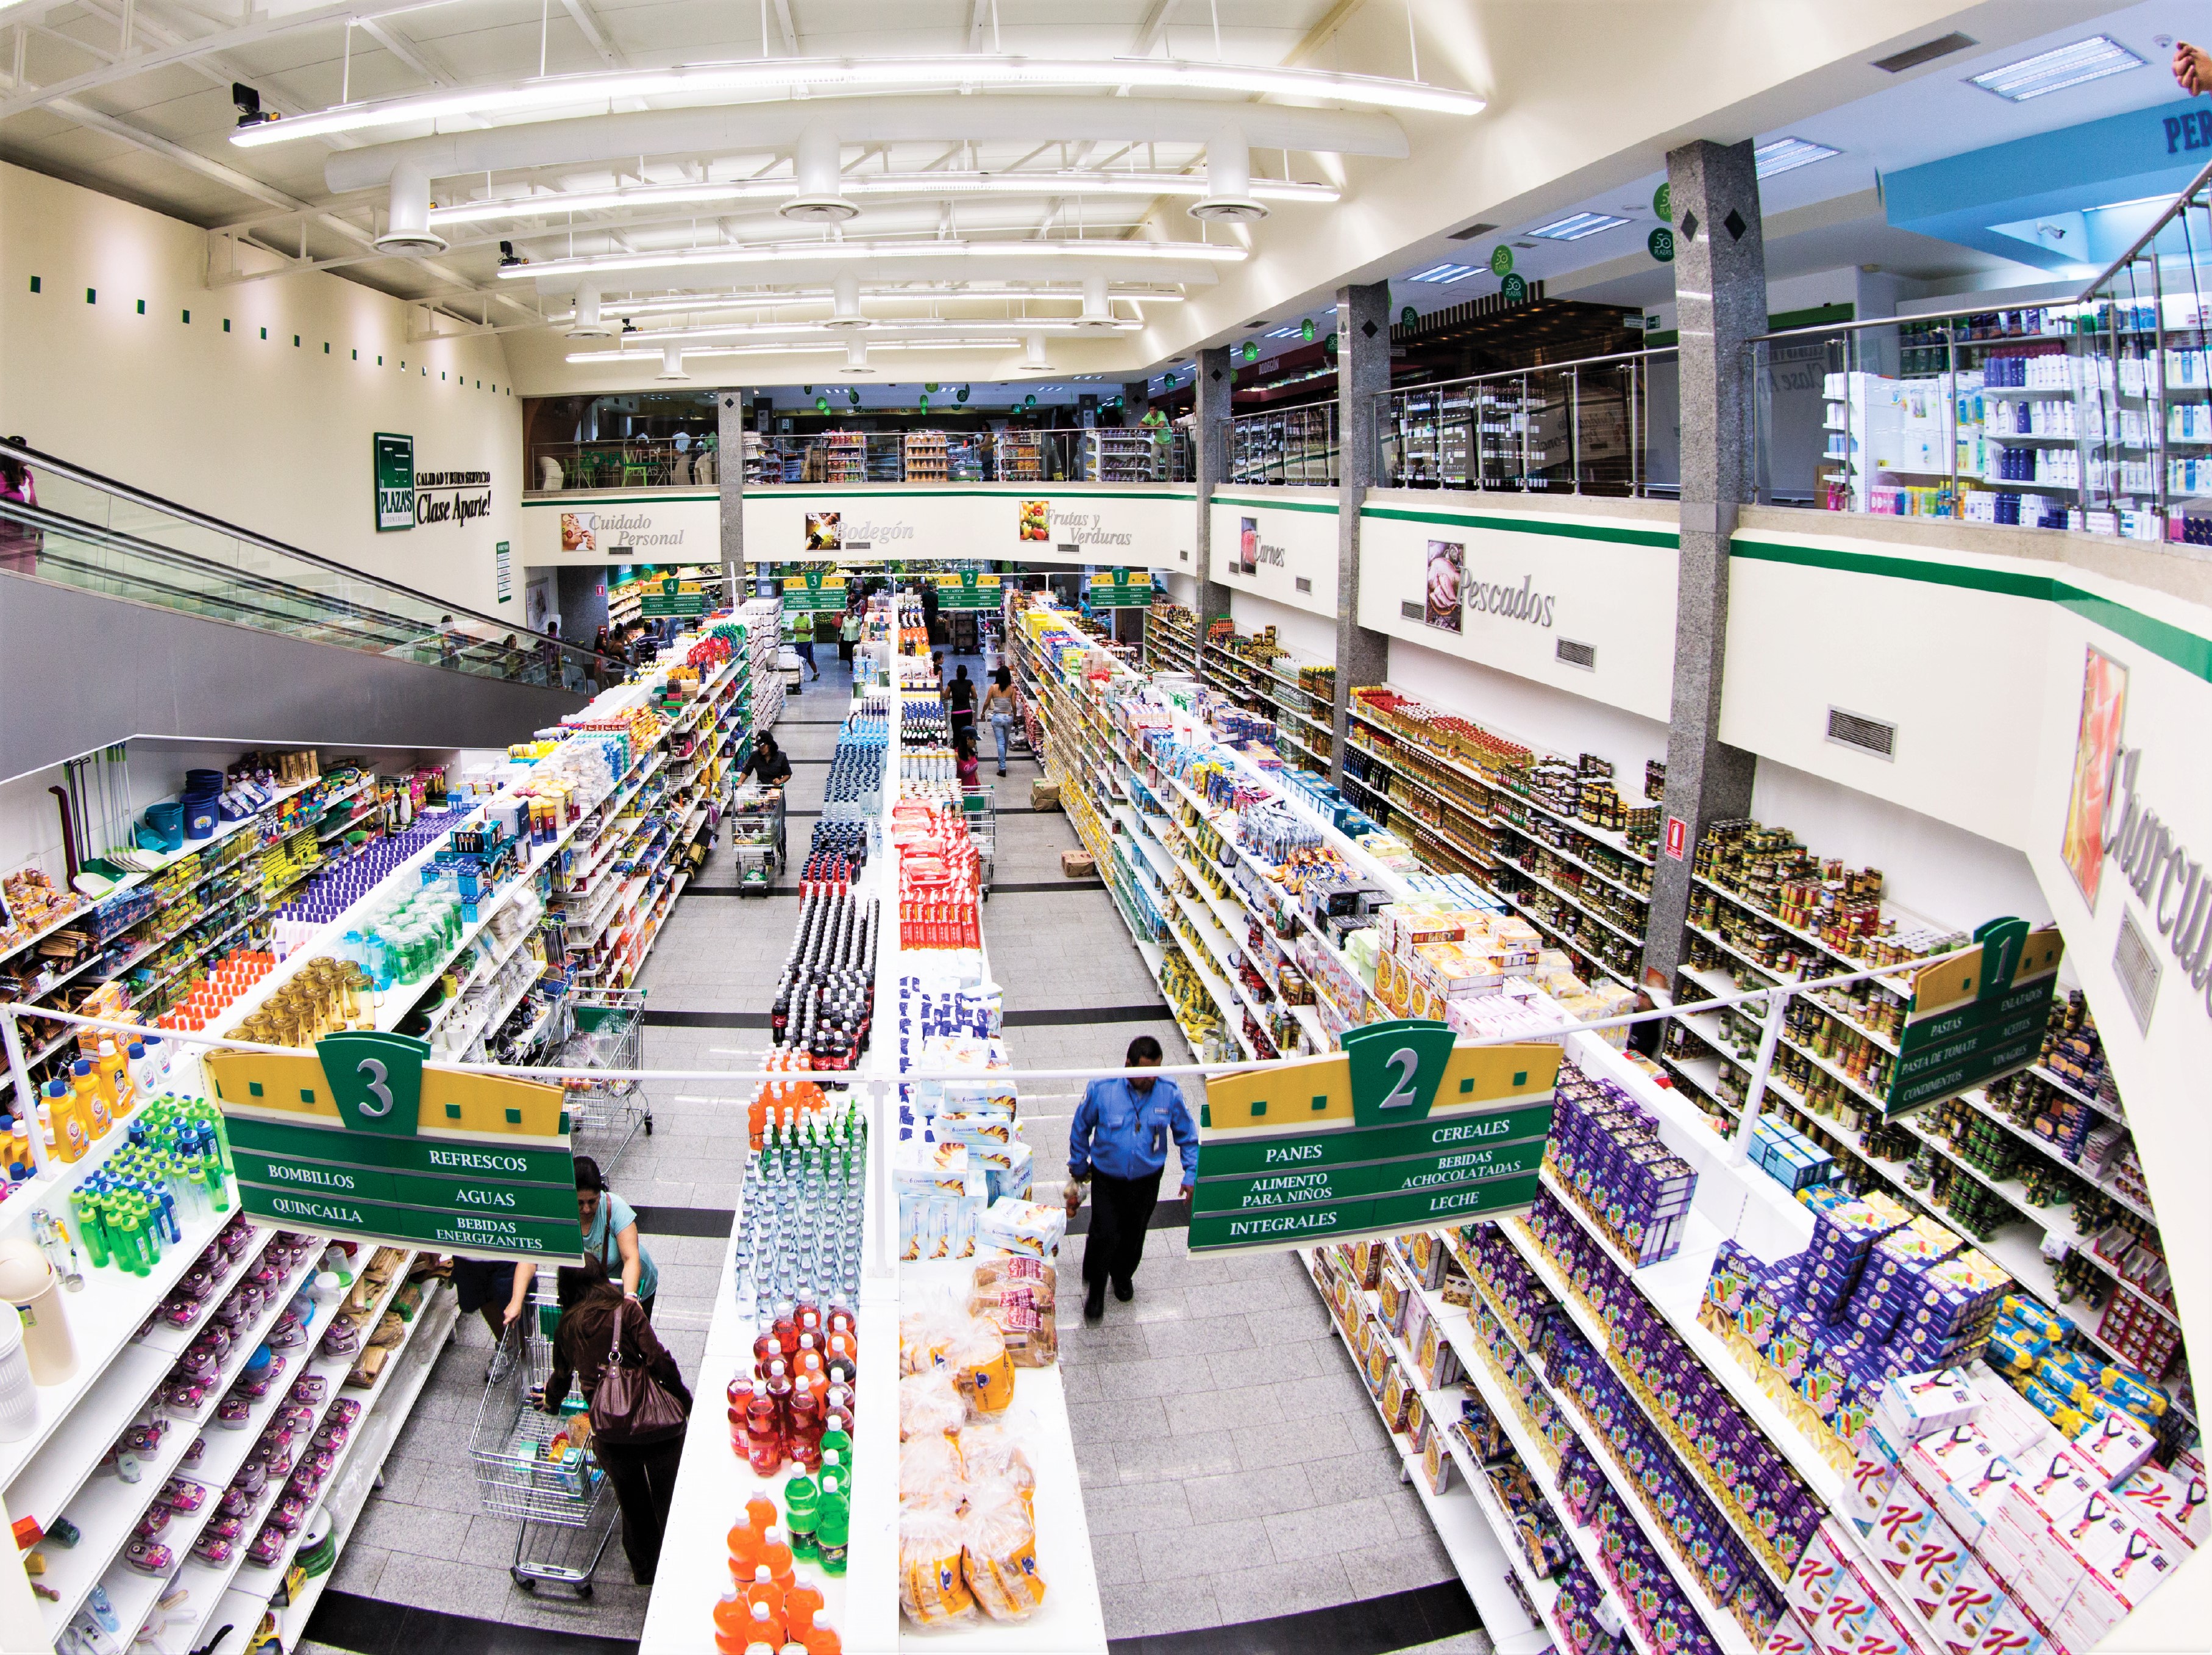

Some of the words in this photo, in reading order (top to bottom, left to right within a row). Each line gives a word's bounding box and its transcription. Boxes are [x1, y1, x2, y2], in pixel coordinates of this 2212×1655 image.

[1654, 233, 1671, 249] 50
[1495, 250, 1508, 265] 50
[1506, 278, 1521, 290] 50
[416, 472, 444, 486] CALIDAD
[444, 472, 449, 485] Y
[450, 472, 464, 485] BUEN
[465, 471, 490, 484] SERVICIO
[380, 489, 412, 513] PLAZA'S
[417, 493, 450, 525] Clase
[452, 490, 491, 528] Aparte!
[589, 514, 652, 530] Cuidado
[1045, 509, 1089, 525] Frutas
[1090, 514, 1100, 529] y
[617, 530, 684, 546] Personal
[834, 521, 914, 543] Bodegón
[1070, 528, 1132, 545] Verduras
[1254, 535, 1286, 568] Carnes
[667, 581, 675, 592] 4
[811, 575, 817, 586] 3
[966, 573, 973, 585] 2
[1118, 572, 1123, 583] 1
[1455, 566, 1556, 627] Pescados
[1991, 936, 2011, 985] 1
[2001, 987, 2043, 1012] ENLATADOS
[1930, 1017, 1963, 1037] PASTAS
[2002, 1018, 2031, 1037] ACEITES
[1901, 1056, 1929, 1075] PASTA
[1930, 1052, 1942, 1064] DE
[1943, 1038, 1978, 1059] TOMATE
[1993, 1044, 2027, 1066] VINAGRES
[356, 1058, 393, 1117] 3
[1379, 1047, 1418, 1109] 2
[1903, 1070, 1963, 1102] CONDIMENTOS
[1432, 1120, 1510, 1144] CEREALES
[429, 1150, 528, 1172] REFRESCOS
[1265, 1145, 1322, 1163] PANES
[1437, 1151, 1492, 1169] BEBIDAS
[268, 1165, 355, 1189] BOMBILLOS
[1251, 1173, 1328, 1192] ALIMENTO
[1401, 1161, 1521, 1189] ACHOCOLATADAS
[456, 1188, 516, 1207] AGUAS
[1242, 1192, 1282, 1207] PARA
[1286, 1186, 1332, 1203] NIÑOS
[1430, 1191, 1479, 1211] LECHE
[272, 1198, 364, 1223] QUINCALLA
[457, 1217, 516, 1234] BEBIDAS
[1230, 1212, 1337, 1236] INTEGRALES
[436, 1229, 542, 1250] ENERGIZANTES
